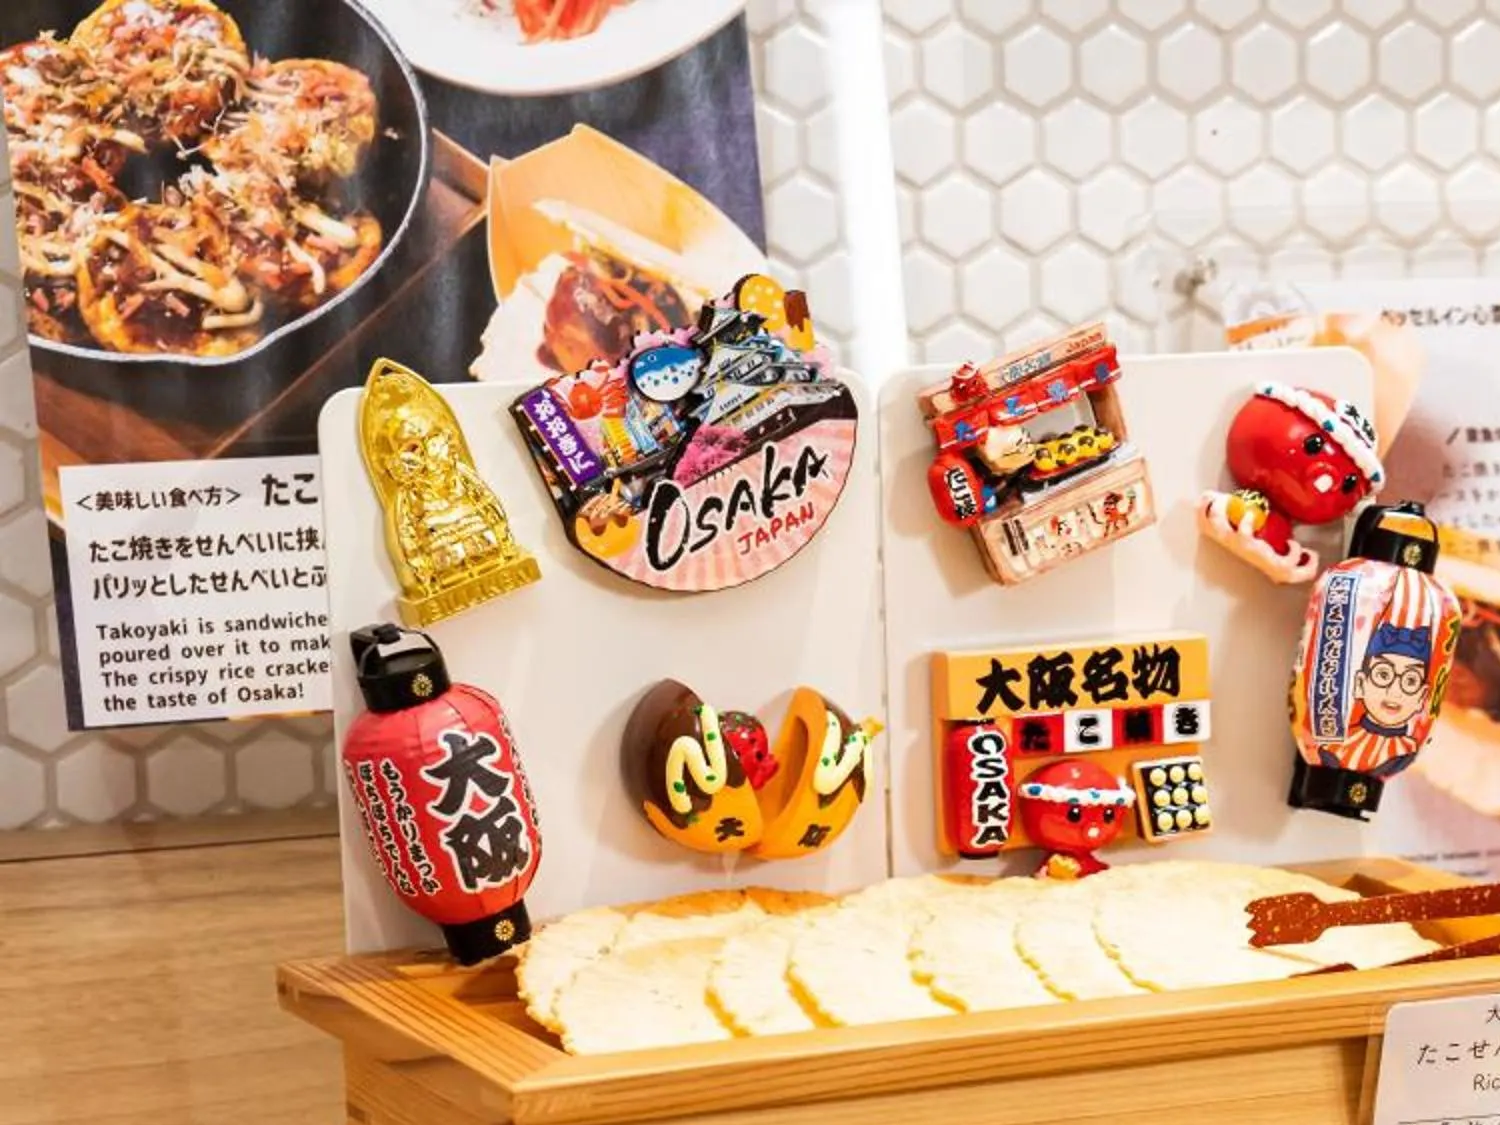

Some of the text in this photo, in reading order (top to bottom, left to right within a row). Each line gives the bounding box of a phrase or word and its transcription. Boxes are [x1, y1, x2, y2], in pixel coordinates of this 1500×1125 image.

[88, 526, 326, 564] たこ焼きをせんべいに挟
[737, 501, 814, 555] JAPAN
[96, 611, 328, 642] Takoyaki is sandwiche
[99, 633, 331, 668] poured over it to mak
[101, 658, 333, 688] The crispy rice cracke
[103, 682, 305, 712] the taste of Osaka!
[975, 643, 1181, 715] 大阪名物
[969, 731, 1009, 846] OSAKA
[380, 759, 442, 895] もうかりまっか
[422, 731, 531, 893] 大阪
